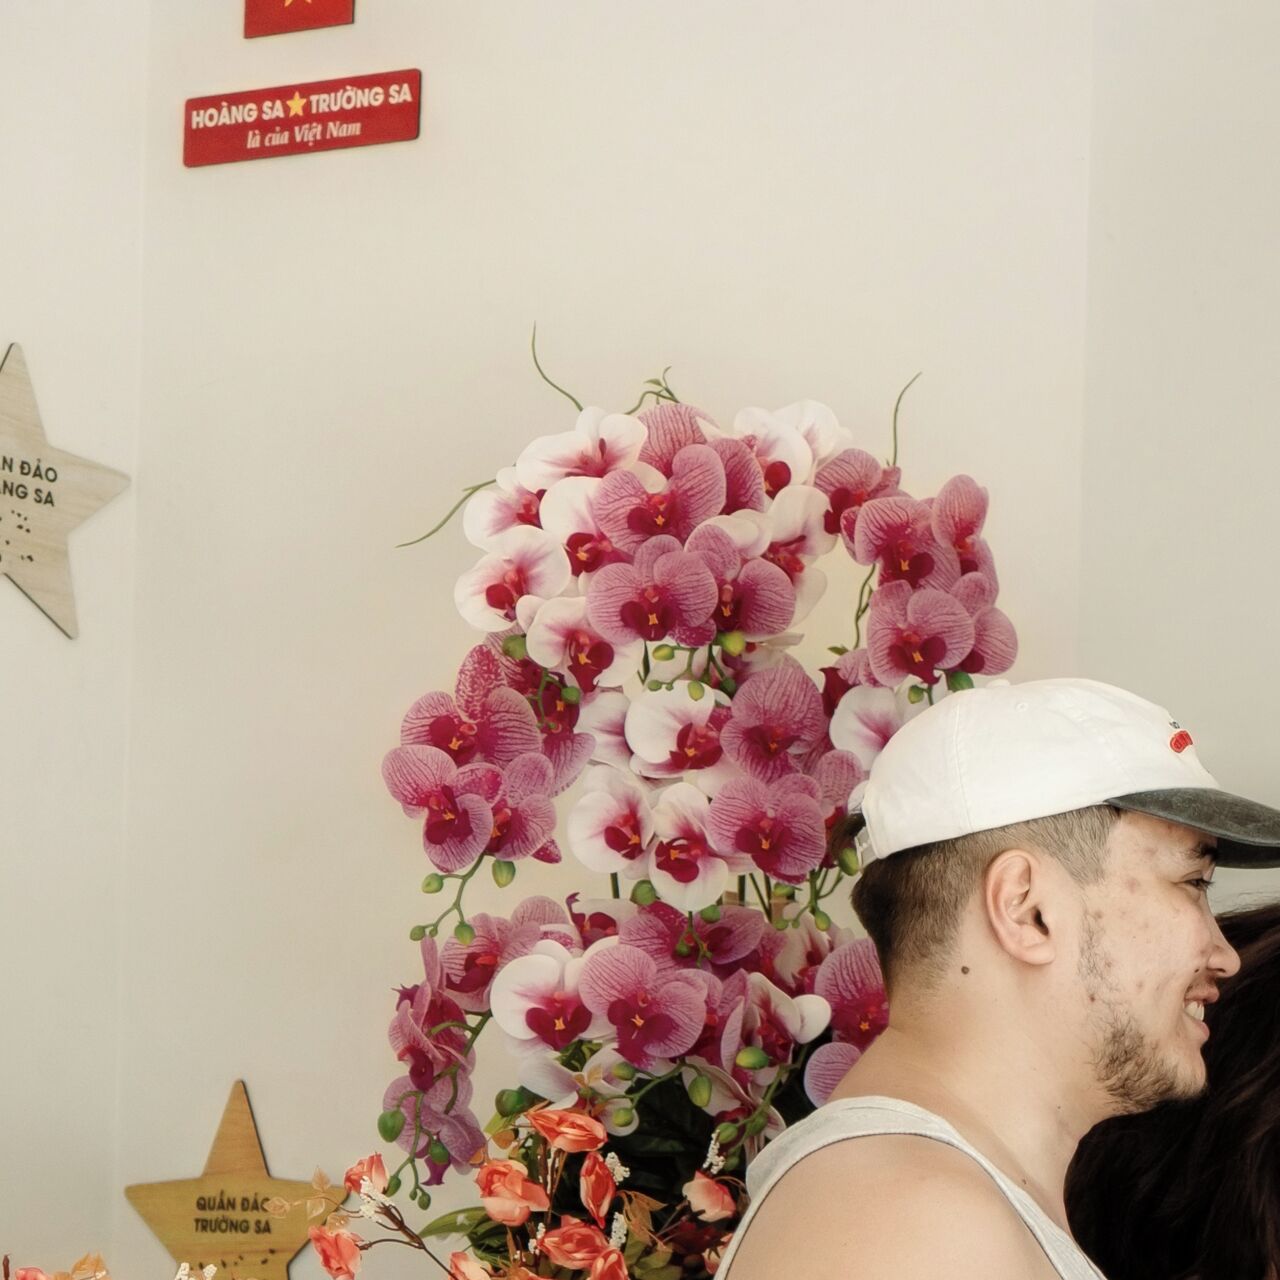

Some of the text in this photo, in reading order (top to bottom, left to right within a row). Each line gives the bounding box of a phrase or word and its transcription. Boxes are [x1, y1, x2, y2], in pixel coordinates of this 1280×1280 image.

[191, 83, 412, 130] HOÀNG SA TRƯỜNG SA
[247, 121, 361, 149] là của Việt Nam
[19, 458, 58, 483] ĐẢO
[34, 488, 55, 507] SA
[254, 1219, 271, 1234] SA
